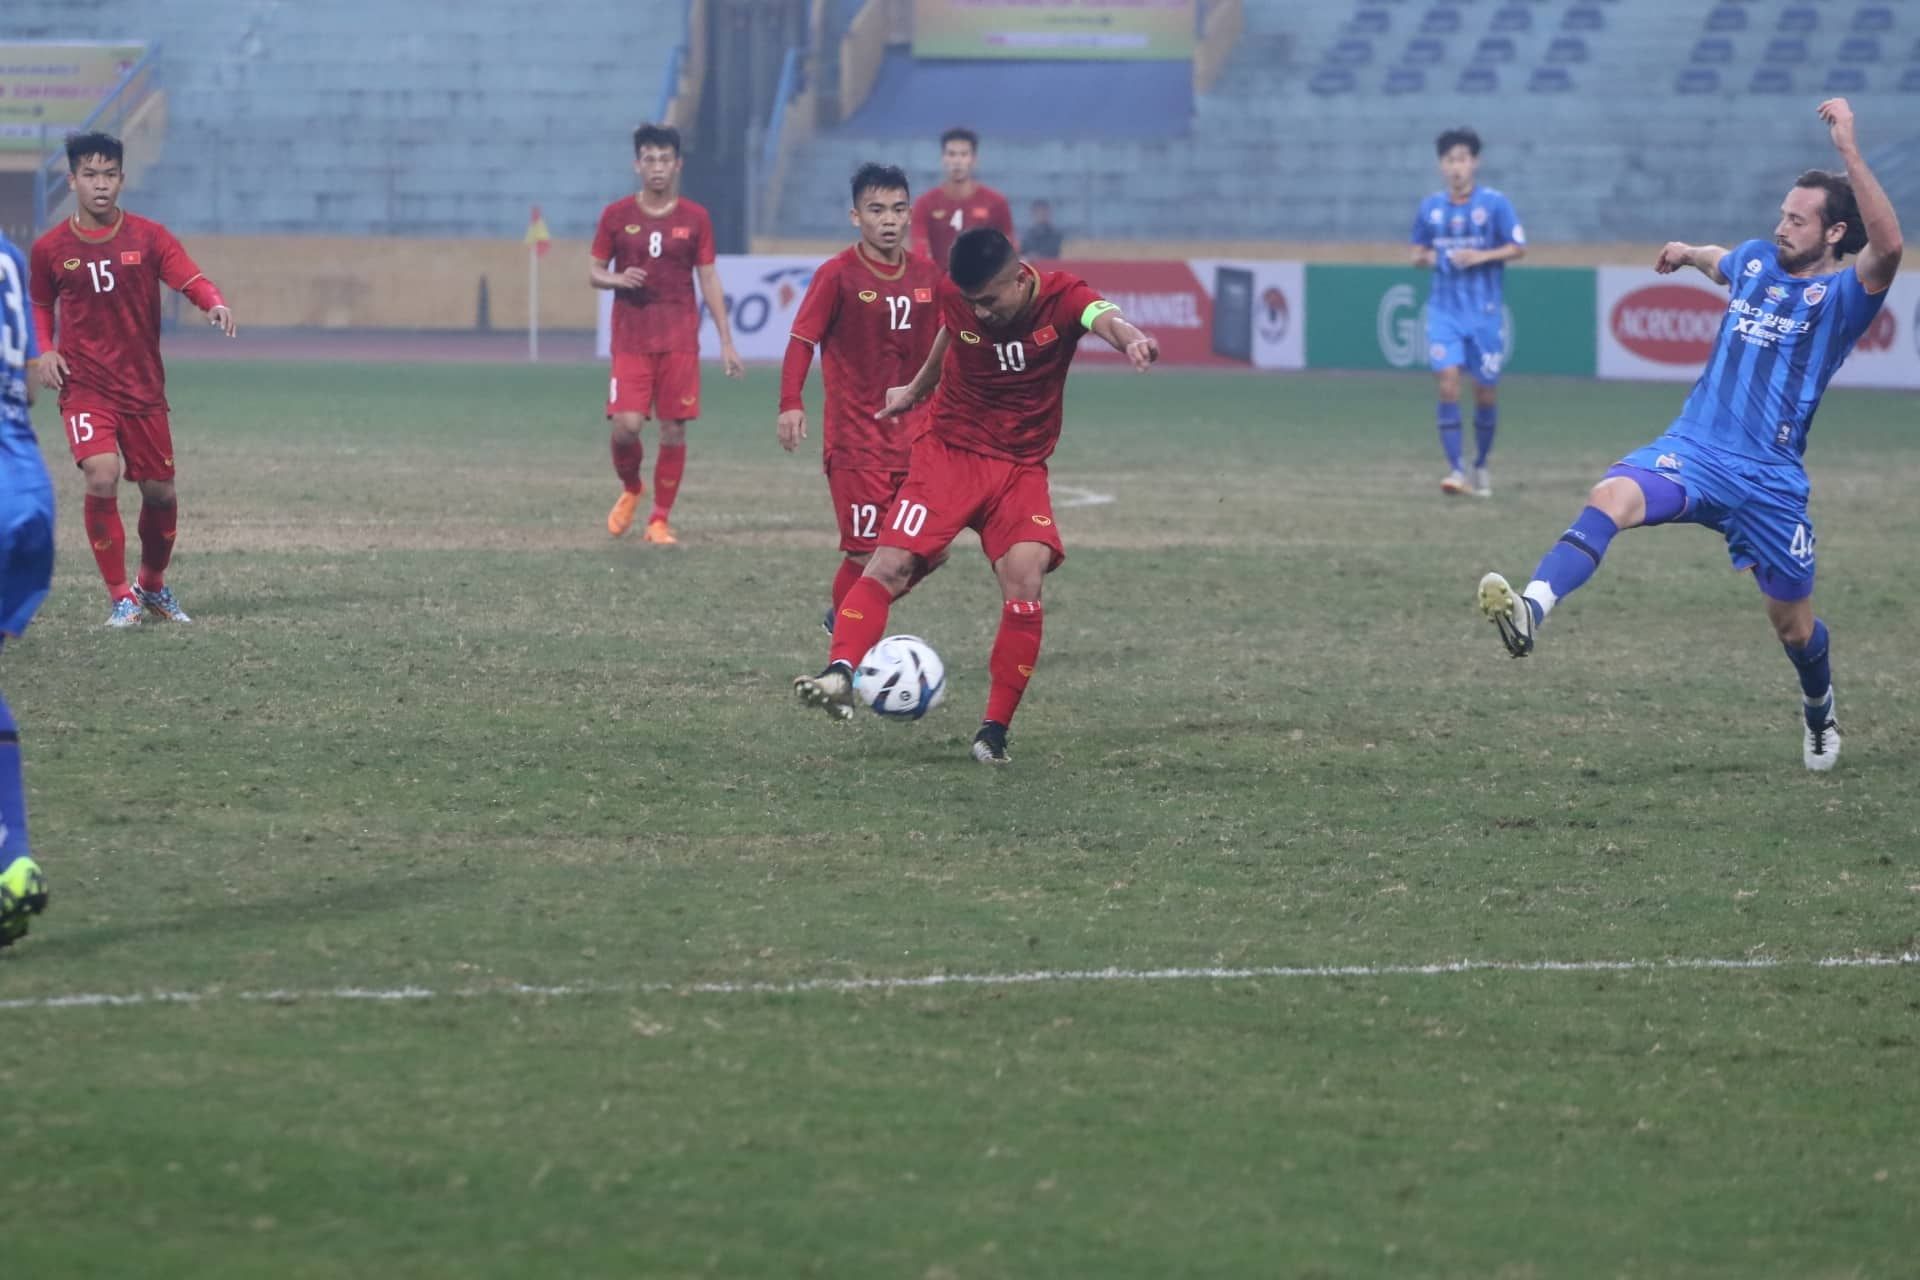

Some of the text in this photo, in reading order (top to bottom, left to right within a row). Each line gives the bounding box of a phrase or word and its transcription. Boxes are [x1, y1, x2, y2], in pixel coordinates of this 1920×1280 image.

[950, 209, 963, 231] 4
[649, 232, 662, 258] 8
[87, 260, 115, 293] 15
[886, 296, 911, 330] 12
[993, 341, 1026, 372] 10
[70, 413, 94, 444] 15
[851, 503, 877, 537] 12
[892, 499, 927, 537] 10
